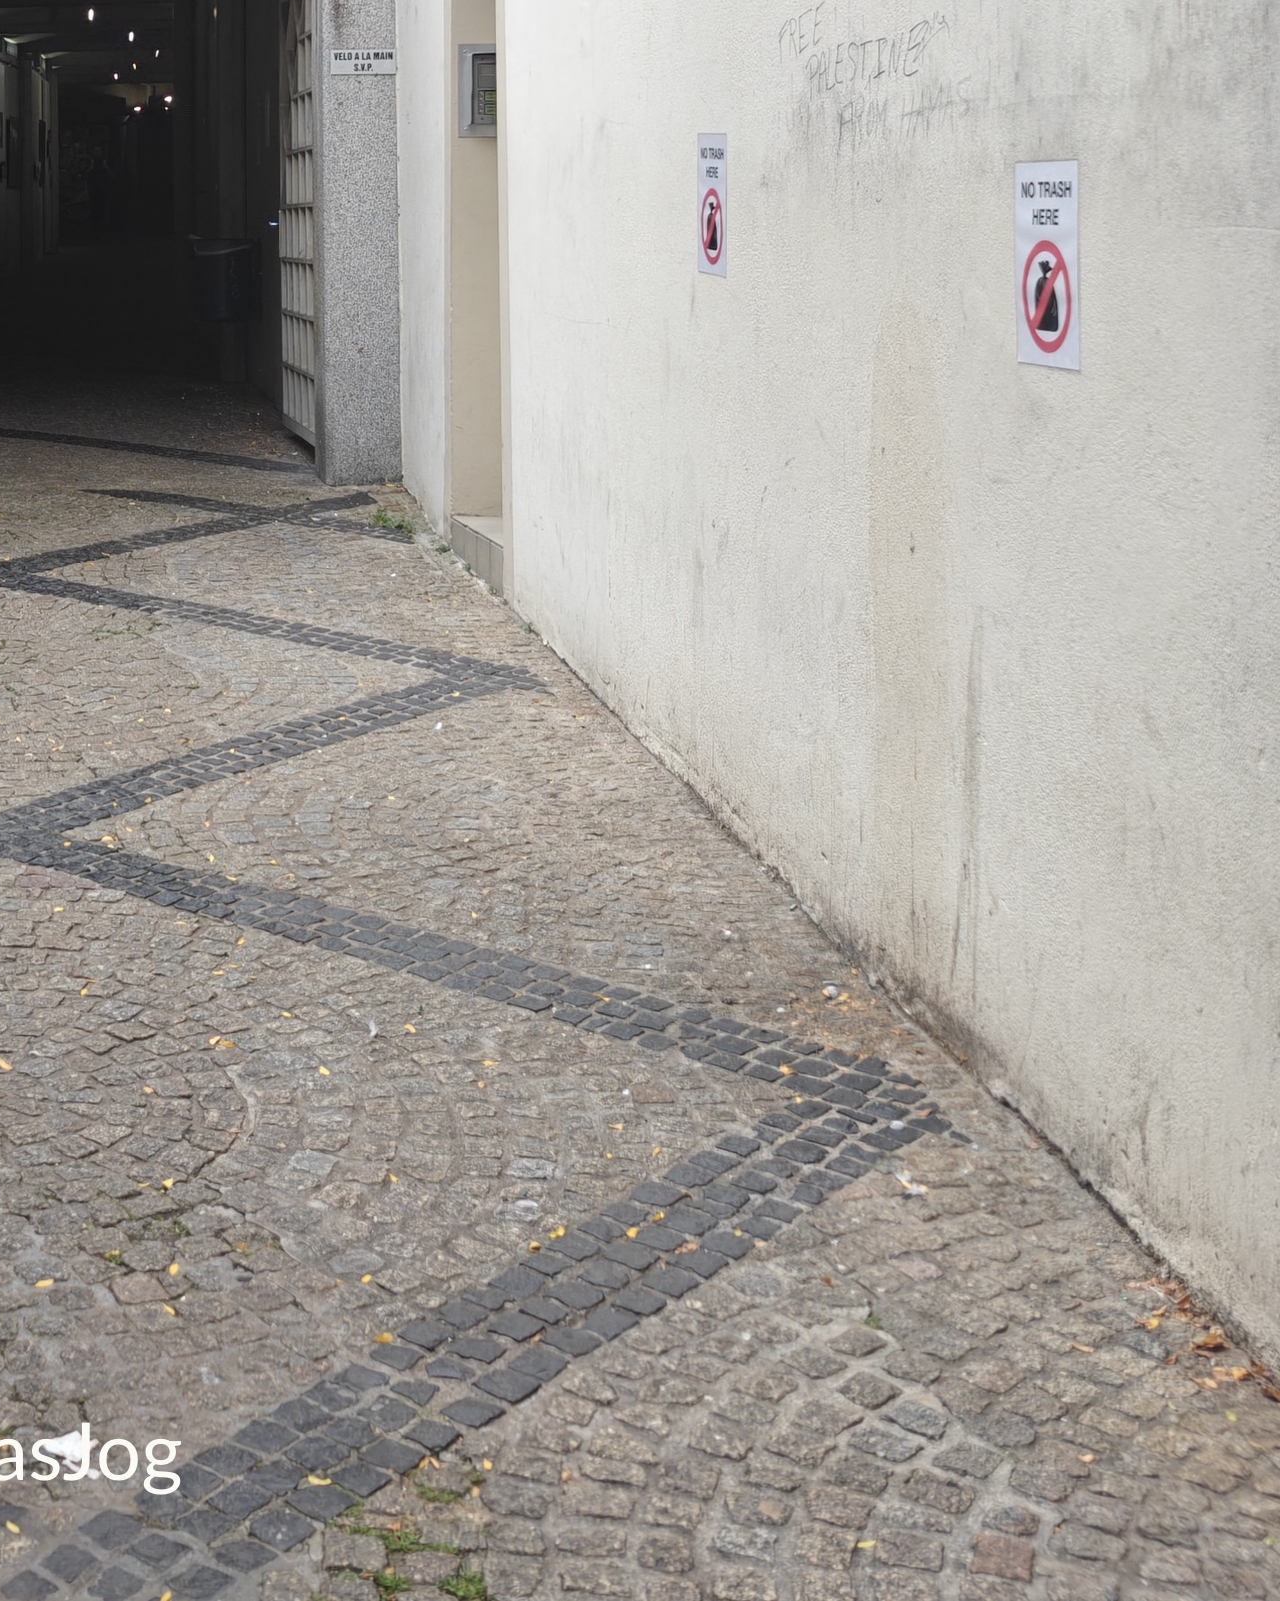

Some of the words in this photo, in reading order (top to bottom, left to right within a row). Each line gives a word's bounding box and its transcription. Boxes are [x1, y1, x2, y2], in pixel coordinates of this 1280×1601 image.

[778, 0, 826, 62] FREE
[334, 52, 353, 61] VELO
[354, 52, 360, 61] A
[361, 52, 371, 61] LA
[373, 52, 393, 60] MAIN
[353, 63, 373, 72] S.V.P.
[700, 147, 708, 159] NO
[708, 147, 724, 160] TRASH
[706, 166, 718, 179] HERE
[1021, 181, 1035, 198] NO
[1038, 181, 1072, 198] TRASH
[1032, 208, 1059, 226] HERE
